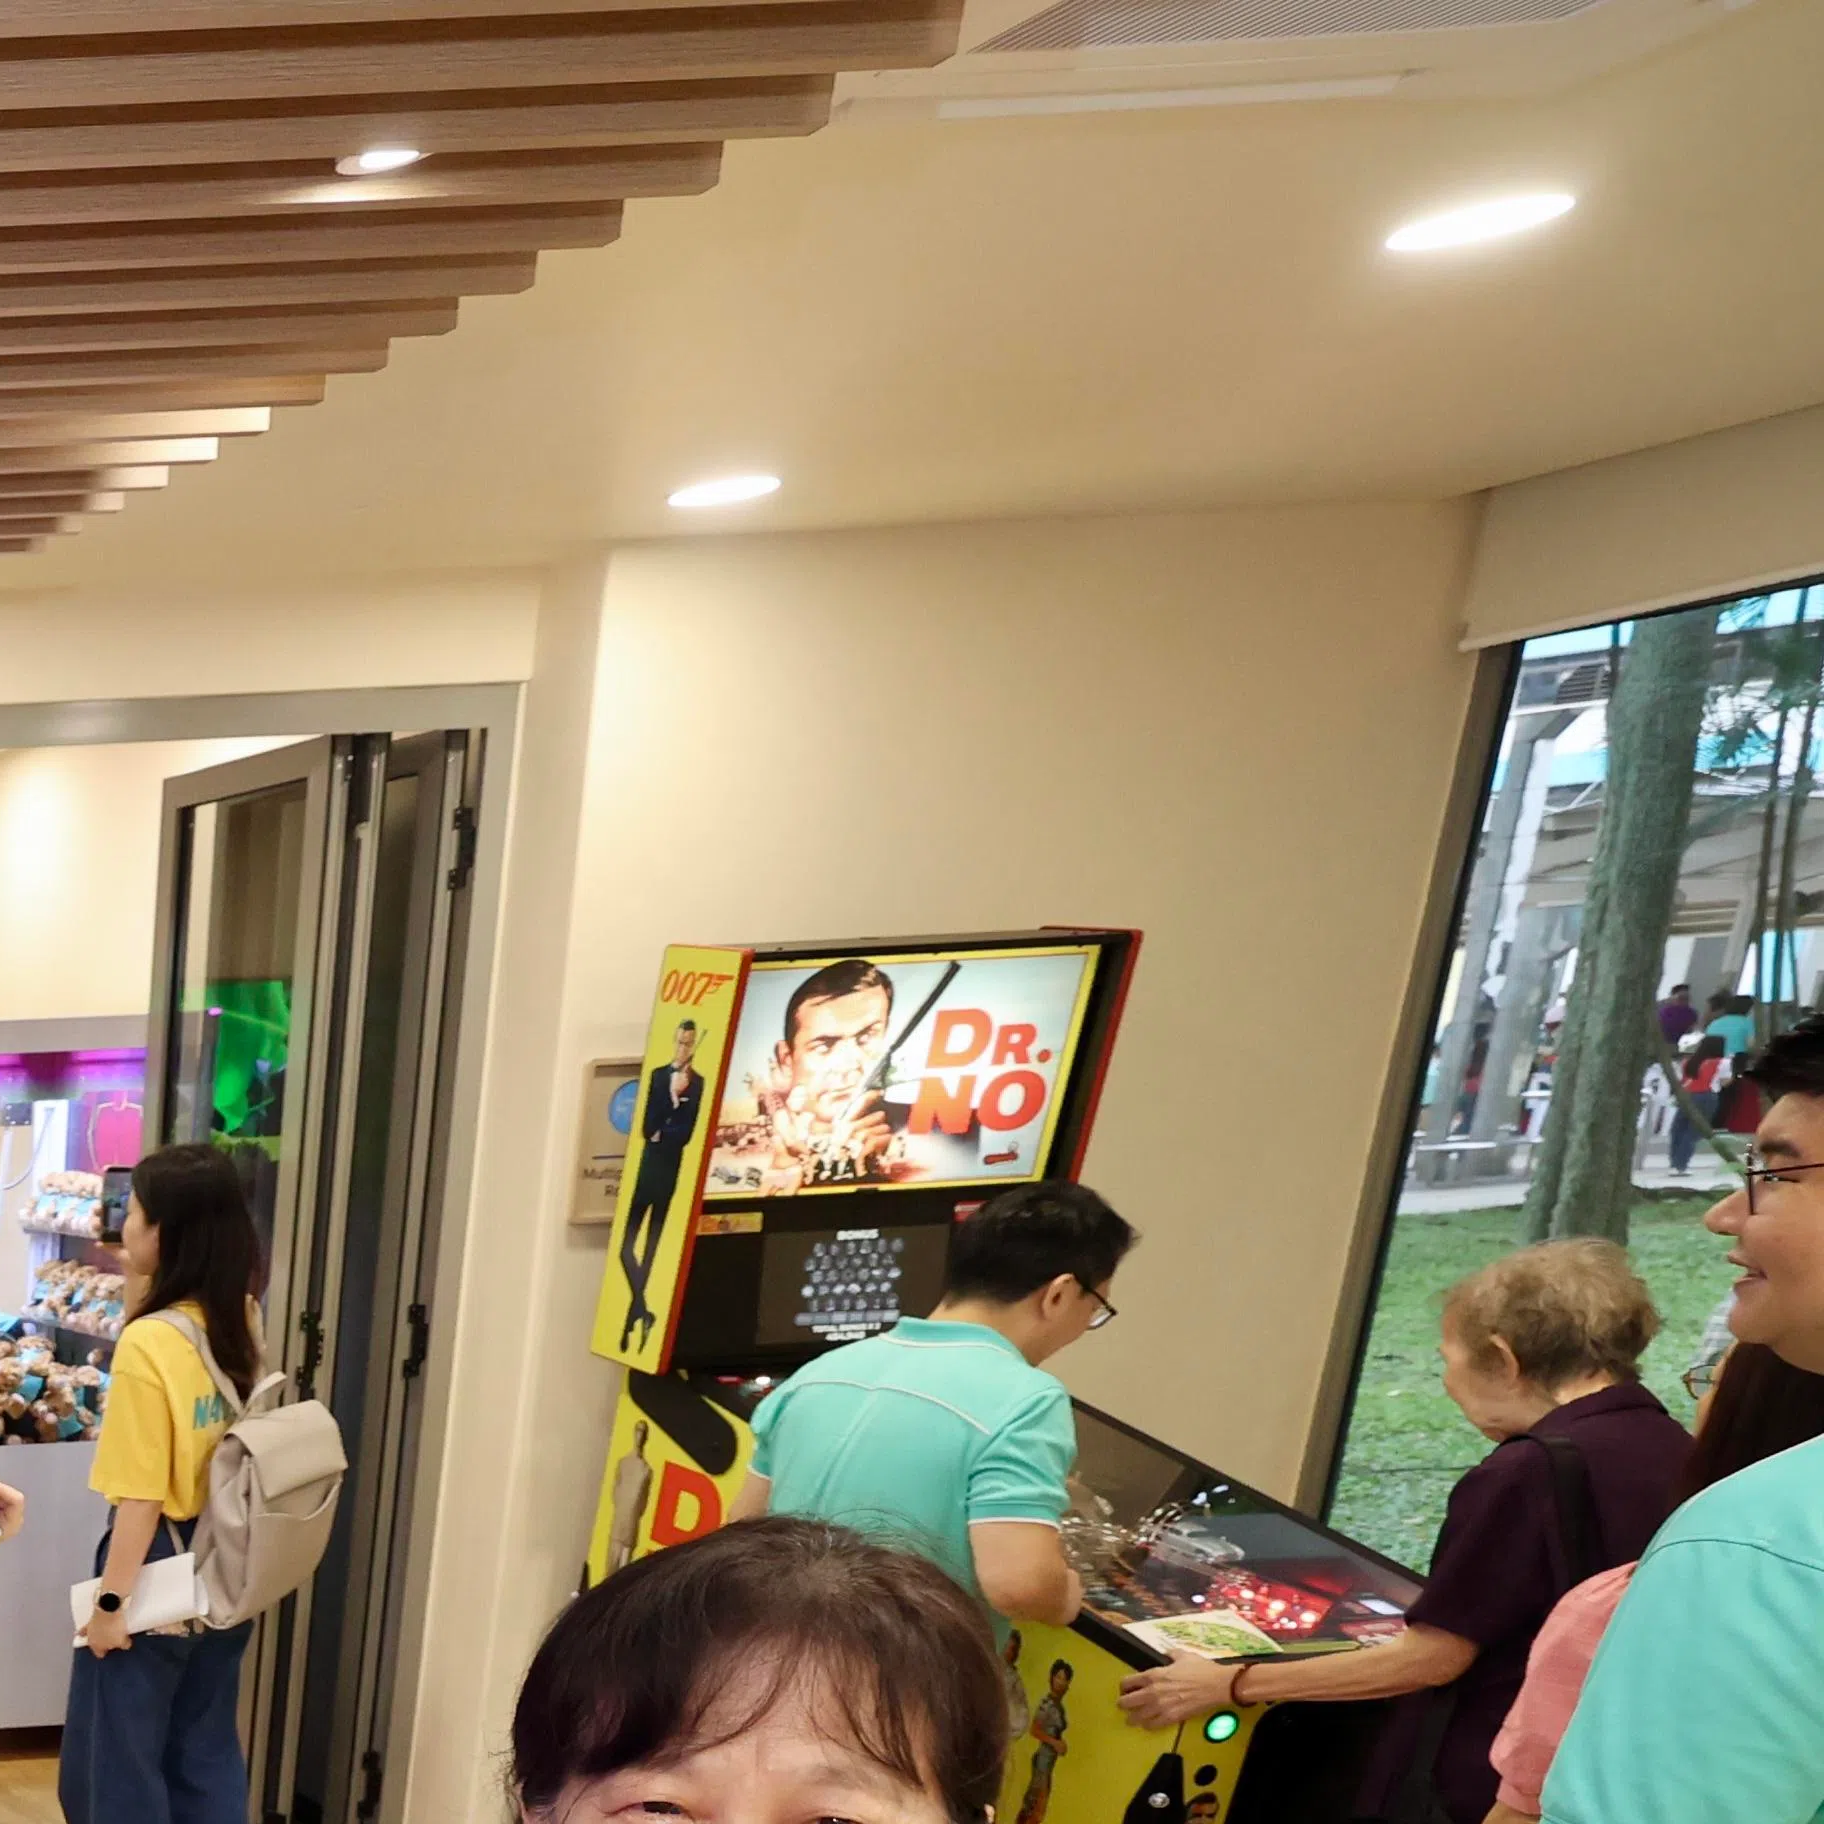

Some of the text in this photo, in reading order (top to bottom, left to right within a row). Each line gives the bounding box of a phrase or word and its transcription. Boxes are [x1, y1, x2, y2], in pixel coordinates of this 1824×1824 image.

[660, 969, 734, 1006] 007
[925, 1008, 1053, 1069] DR.
[907, 1069, 1047, 1135] NO
